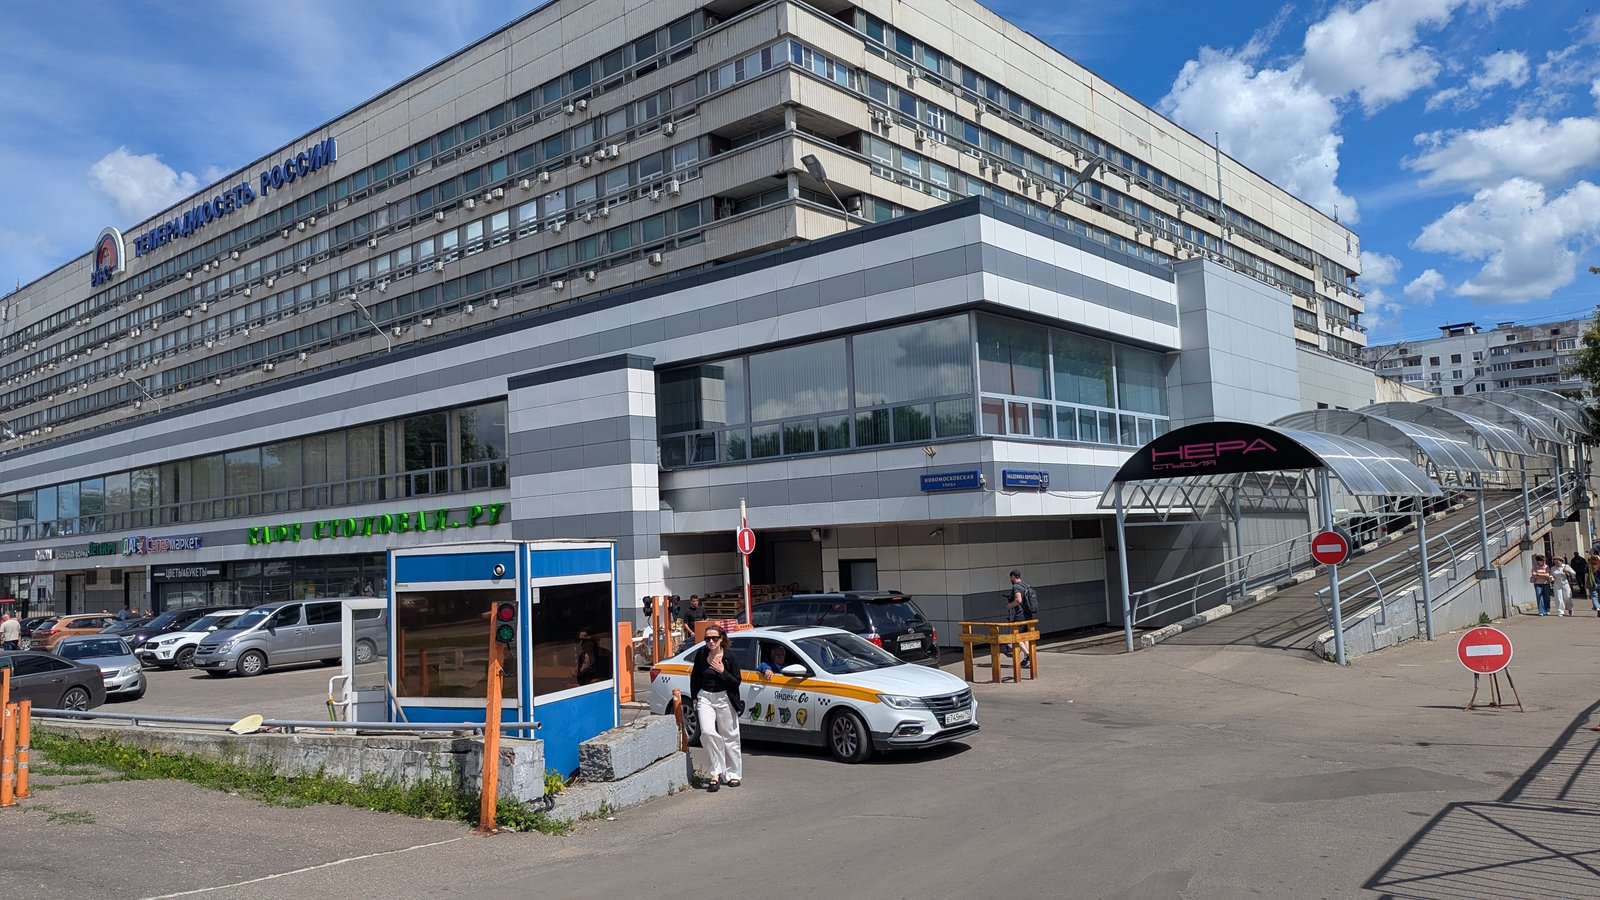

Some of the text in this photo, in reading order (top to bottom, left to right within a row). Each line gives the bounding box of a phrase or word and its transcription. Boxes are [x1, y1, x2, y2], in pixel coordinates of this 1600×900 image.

[133, 137, 338, 257] ТЕЛЕРАДИОСЕТЬ РОССИИ
[1152, 438, 1277, 462] НЕРА
[1153, 460, 1216, 471] СТУДИЯ
[924, 474, 974, 483] НОВОМОСКОВСКАЯ
[248, 503, 504, 545] КАФЕ СТОЛОВАЯ.РУ
[774, 690, 810, 704] Яндекс Go
